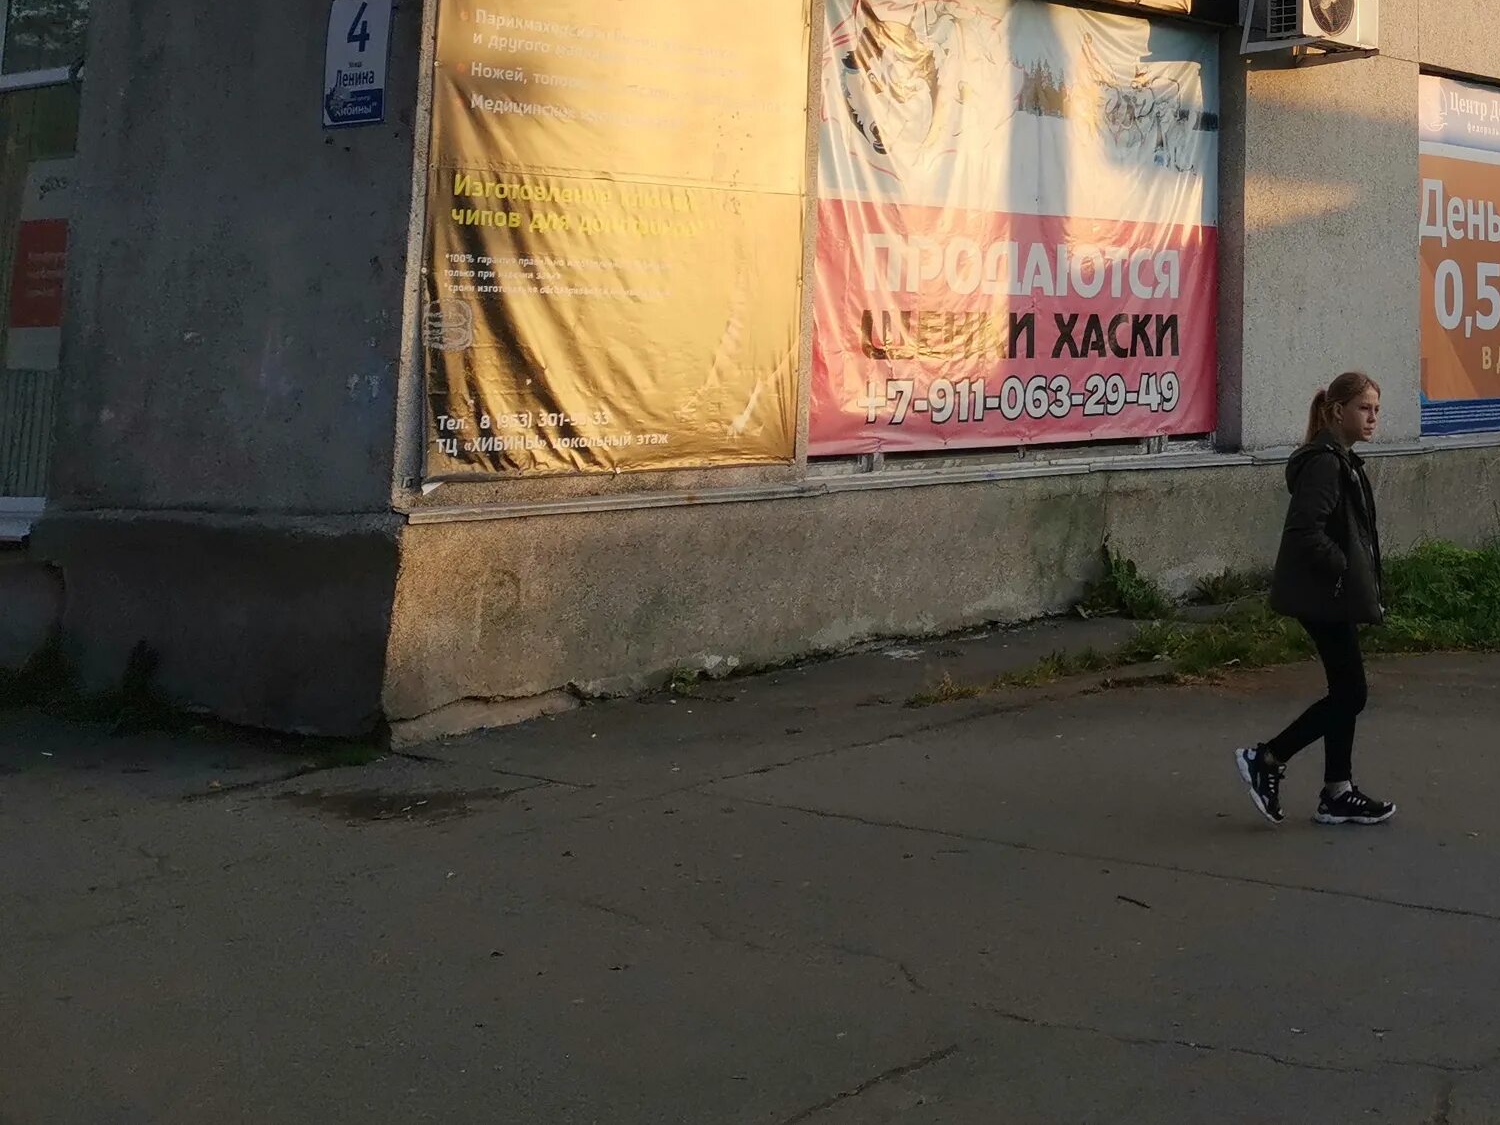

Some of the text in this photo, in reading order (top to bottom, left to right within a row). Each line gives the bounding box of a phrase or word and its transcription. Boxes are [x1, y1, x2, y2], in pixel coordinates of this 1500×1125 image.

[346, 1, 370, 53] 4
[488, 31, 550, 56] другого
[335, 69, 376, 88] Ленина
[471, 61, 529, 84] Ножей,
[1450, 91, 1487, 123] Центр
[454, 174, 610, 211] Изготовление
[451, 208, 521, 229] чипов
[529, 210, 570, 233] для
[478, 270, 495, 281] при
[862, 231, 1180, 300] ПРОДАЮТСЯ
[1051, 312, 1180, 360] ХАСКИ
[1481, 346, 1492, 370] в
[857, 371, 1181, 426] +7-911-063-29-49
[437, 414, 470, 431] Тел.
[480, 414, 491, 429] 8
[436, 437, 458, 457] ТЦ
[637, 433, 670, 446] этаж
